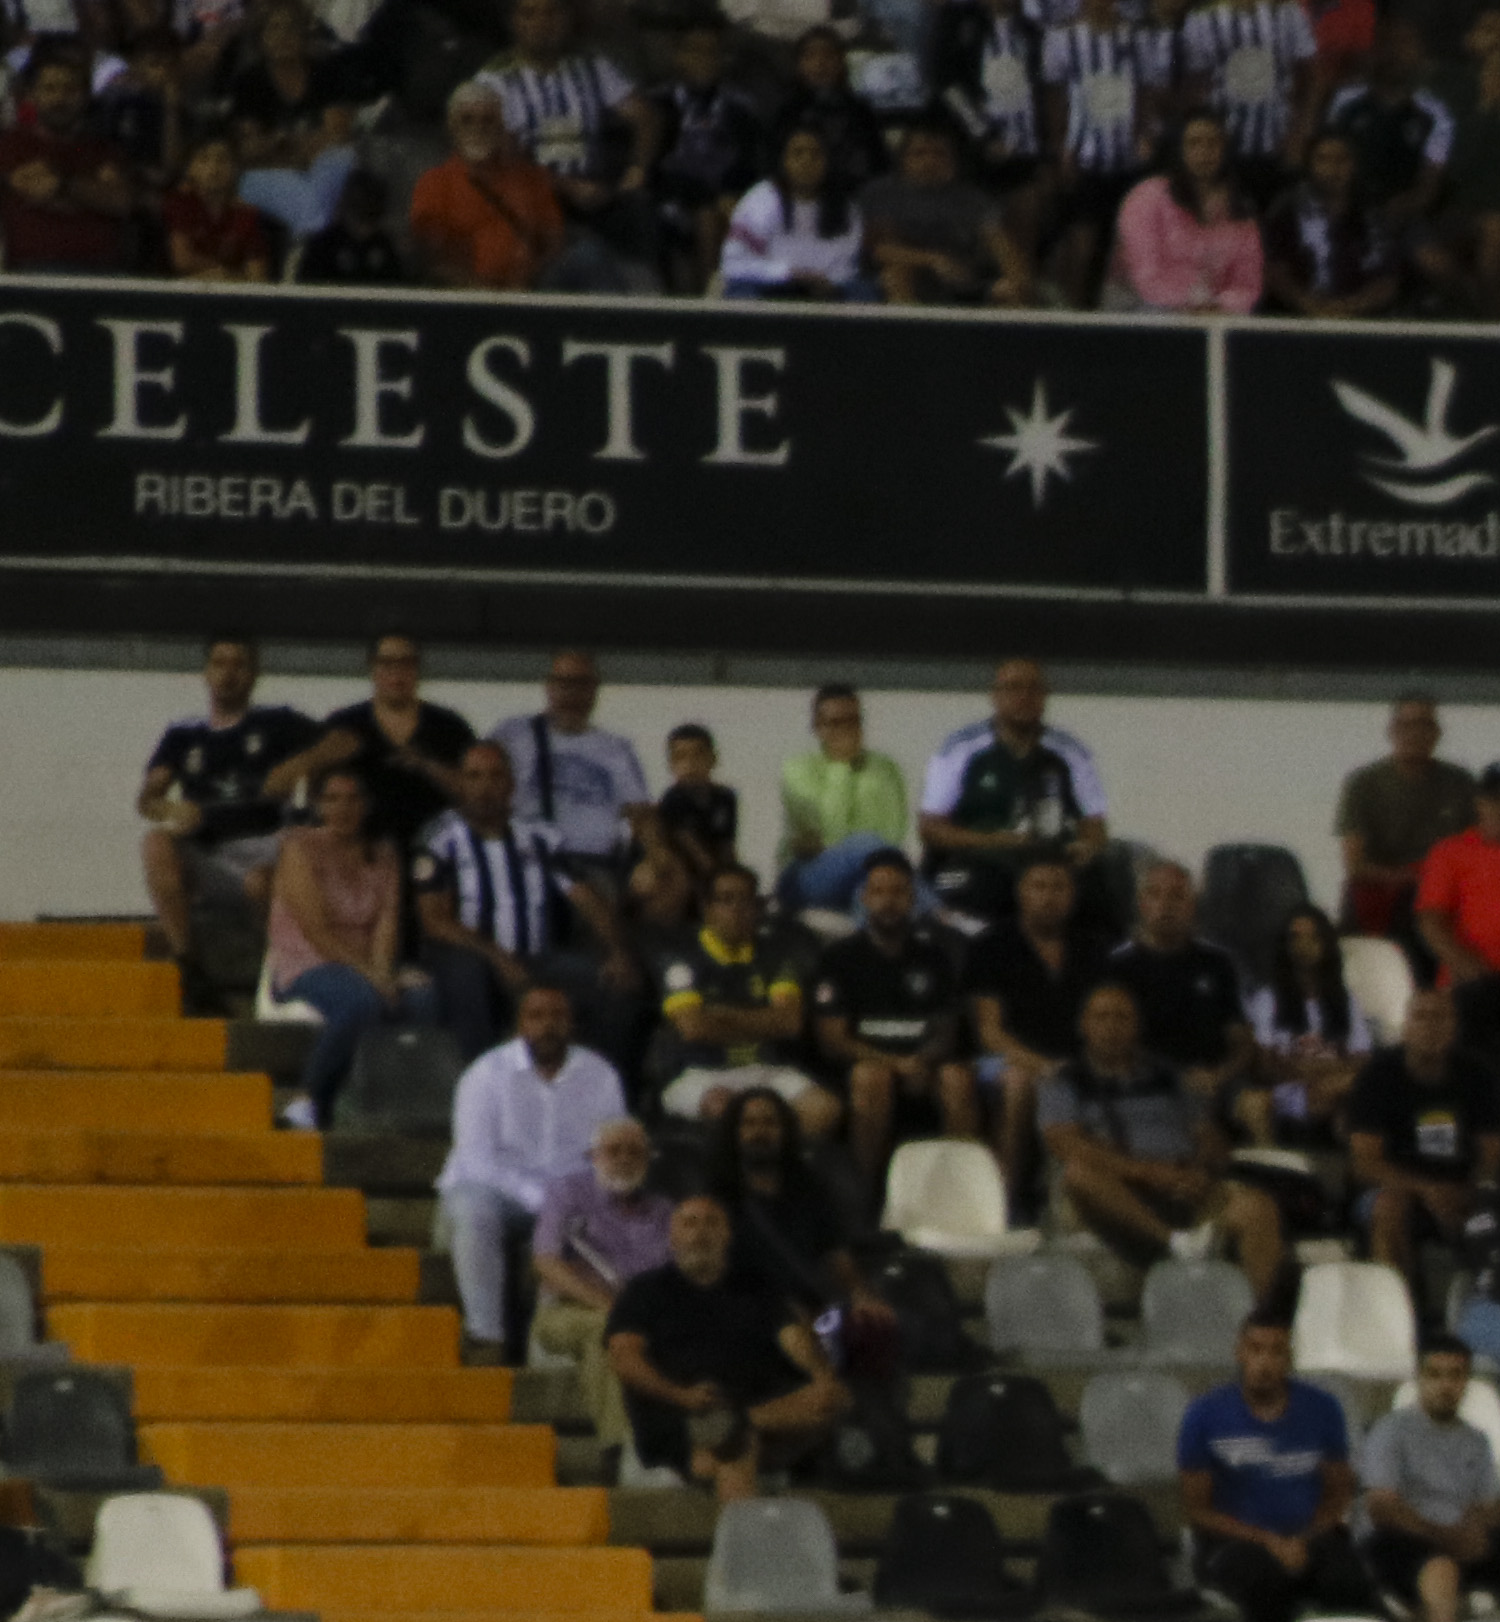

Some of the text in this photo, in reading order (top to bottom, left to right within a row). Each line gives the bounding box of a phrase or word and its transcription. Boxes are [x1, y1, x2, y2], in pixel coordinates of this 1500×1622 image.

[134, 472, 619, 535] RIBERA DEL DUERO
